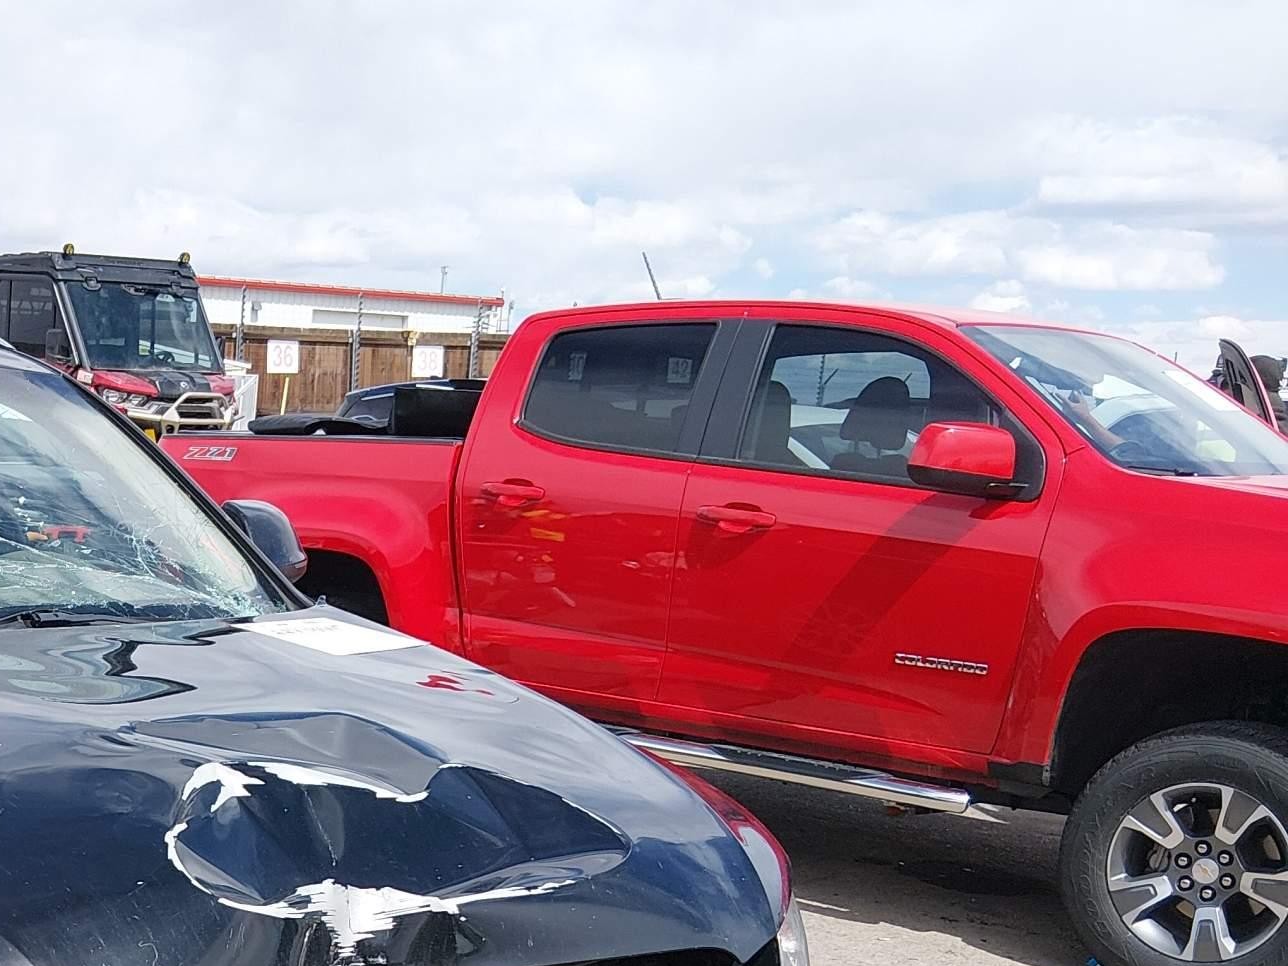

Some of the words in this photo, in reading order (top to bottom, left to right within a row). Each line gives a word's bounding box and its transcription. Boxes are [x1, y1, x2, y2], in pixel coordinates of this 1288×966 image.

[272, 344, 294, 367] 36
[417, 349, 439, 371] 38
[183, 446, 238, 462] Z71
[894, 652, 989, 675] COLORADO
